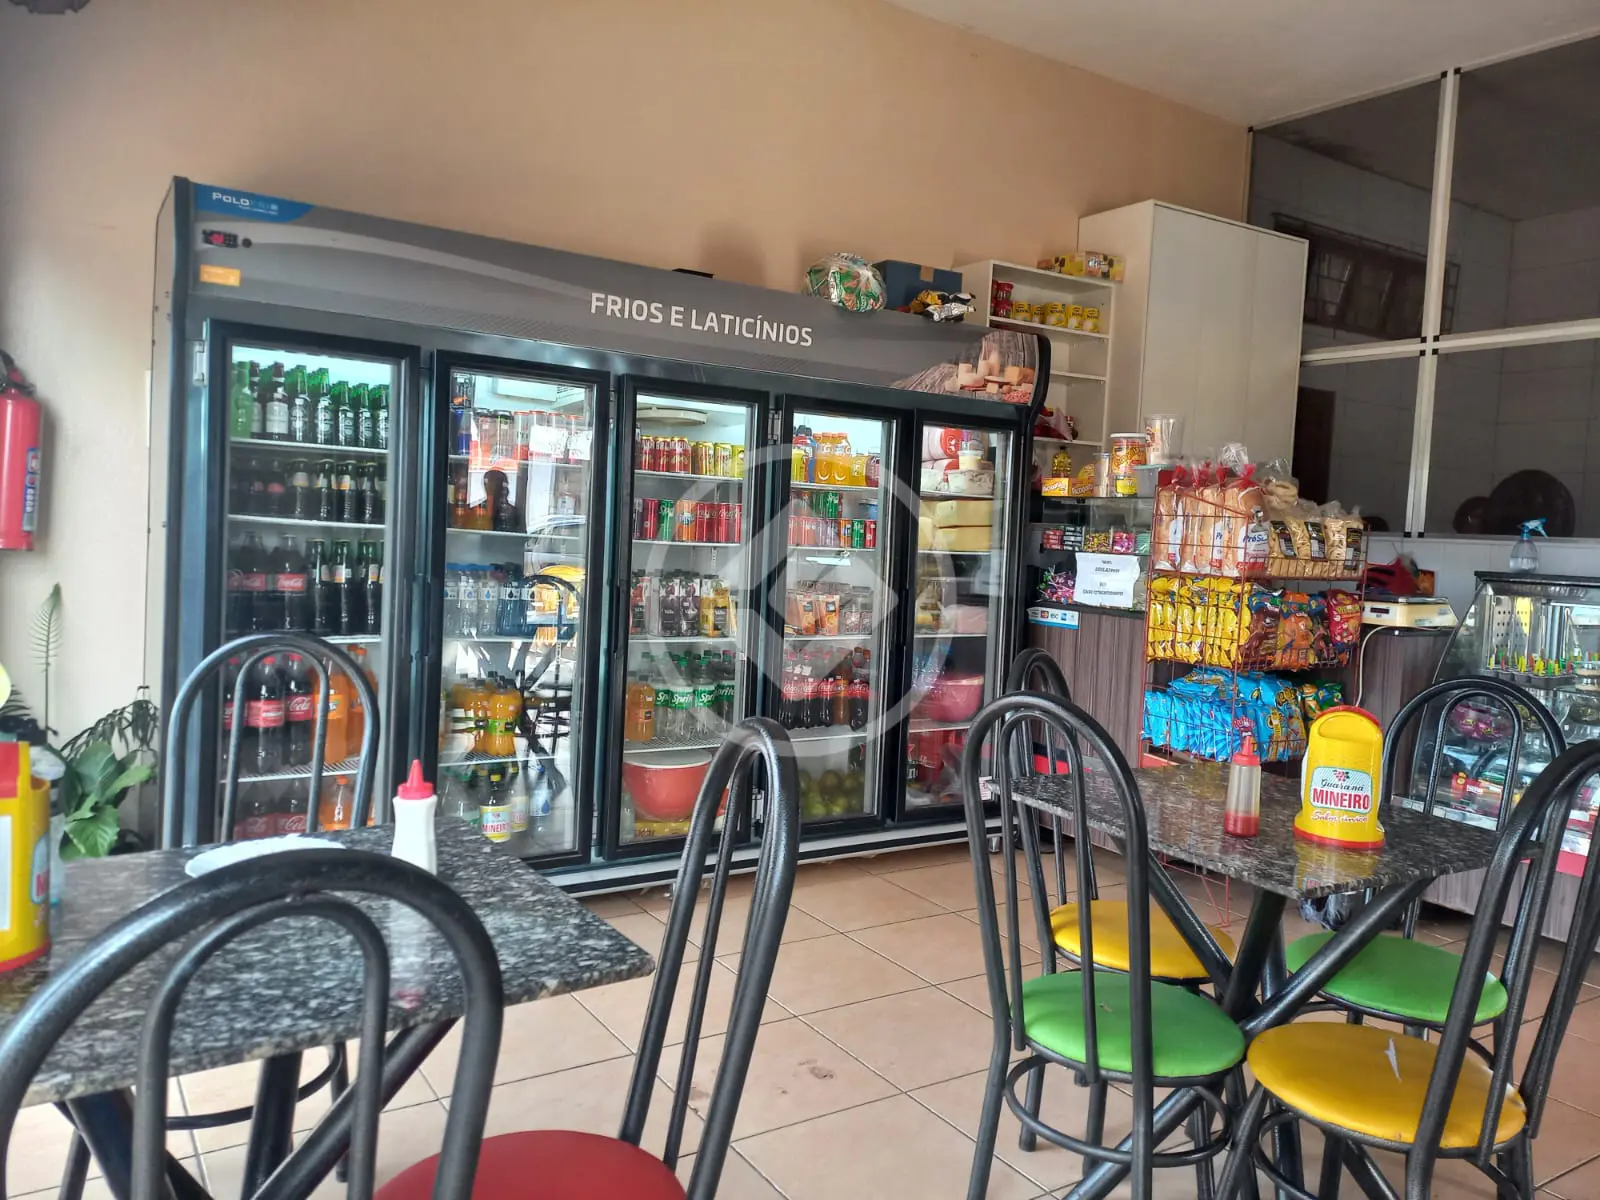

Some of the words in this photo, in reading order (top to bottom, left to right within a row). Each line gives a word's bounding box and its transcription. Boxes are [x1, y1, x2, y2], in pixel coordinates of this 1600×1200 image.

[590, 292, 664, 324] FRIOS
[670, 305, 685, 328] E
[690, 309, 814, 347] LATICÍNIOS
[1312, 788, 1370, 810] MINEIRO
